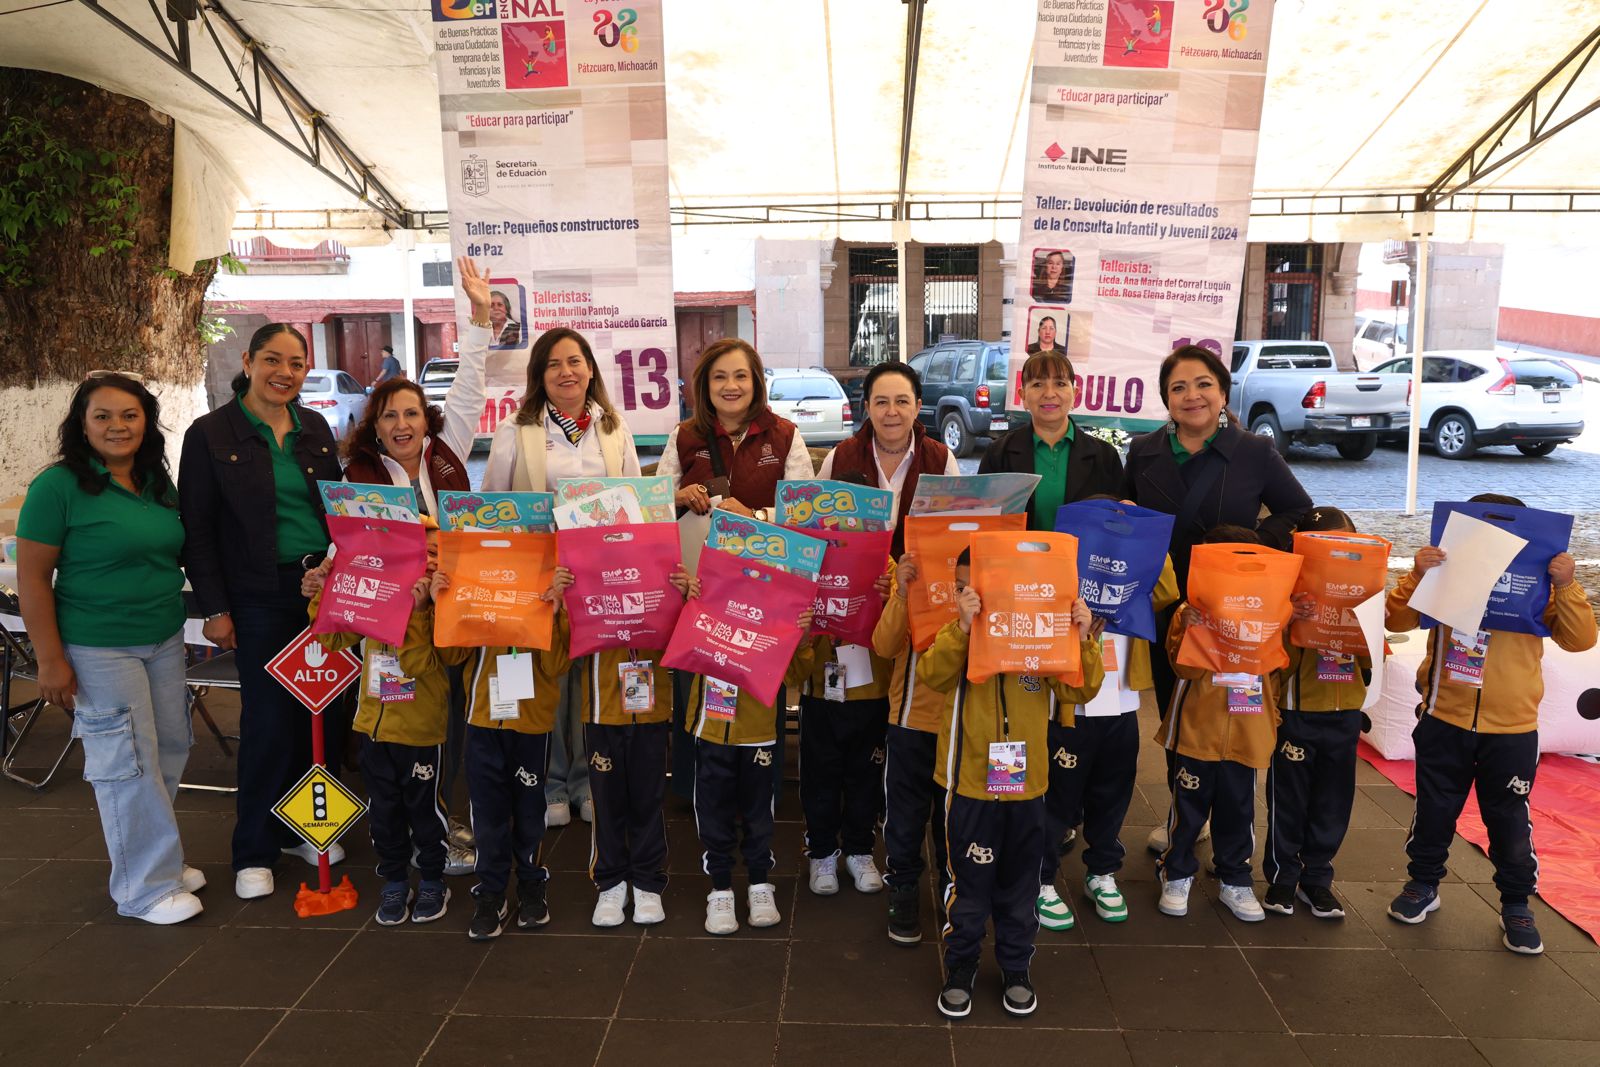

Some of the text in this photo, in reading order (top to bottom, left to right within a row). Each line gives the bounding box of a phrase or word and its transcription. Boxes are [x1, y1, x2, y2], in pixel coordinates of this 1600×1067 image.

[1052, 0, 1075, 9] Buenas
[1038, 12, 1103, 24] hacia una Ciudadanía
[439, 26, 498, 38] de Buenas Prácticas
[1053, 27, 1102, 38] temprana de las
[436, 40, 499, 51] hacia una Ciudadanía
[1059, 39, 1100, 52] Infancias y las
[453, 52, 499, 64] temprana de las
[1064, 52, 1098, 63] Juventudes
[1180, 46, 1262, 61] Pátzcuaro, Michoacán
[459, 65, 500, 76] Infancias y las
[577, 60, 658, 73] Pátzcuaro, Michoacán
[1094, 93, 1114, 106] para
[503, 116, 523, 128] para
[1071, 146, 1127, 165] INE
[496, 160, 537, 168] Secretaría
[1038, 163, 1126, 173] Instituto Nacional Electoral
[509, 169, 547, 177] Eduación
[1036, 196, 1219, 218] Taller: Devolución de resultados
[466, 217, 639, 236] Taller: Pequeños constructores
[1034, 217, 1238, 241] de la Consulta Infantil y Juvenil 2024
[467, 243, 503, 256] de Paz
[1100, 259, 1153, 274] Tallerista:
[1098, 275, 1122, 285] Licda.
[1123, 276, 1139, 286] Ana
[1140, 277, 1163, 287] María
[1164, 278, 1177, 288] del
[1178, 279, 1202, 290] Corral
[532, 291, 592, 304] Talleristas:
[1097, 287, 1121, 297] Licda.
[1122, 289, 1142, 299] Rosa
[1143, 289, 1165, 300] Elena
[1166, 291, 1196, 303] Barajas
[534, 305, 619, 317] Elvira Murillo Pantoja
[571, 319, 603, 330] Patricia
[604, 318, 639, 329] Saucedo
[641, 317, 667, 328] García
[614, 348, 671, 411] 13
[1085, 579, 1098, 588] NA
[1084, 586, 1100, 596] CIO
[1325, 605, 1337, 613] NA
[1325, 612, 1339, 620] CIO
[1015, 621, 1033, 630] CIO
[1223, 625, 1238, 633] CIO
[718, 628, 732, 637] CIO
[1223, 631, 1239, 639] NAL
[1445, 662, 1481, 676] ASISTENTE
[294, 669, 338, 682] ALTO
[1318, 673, 1353, 681] ASISTENTE
[381, 693, 414, 701] ASISTENTE
[706, 703, 735, 715] ASISTENTE
